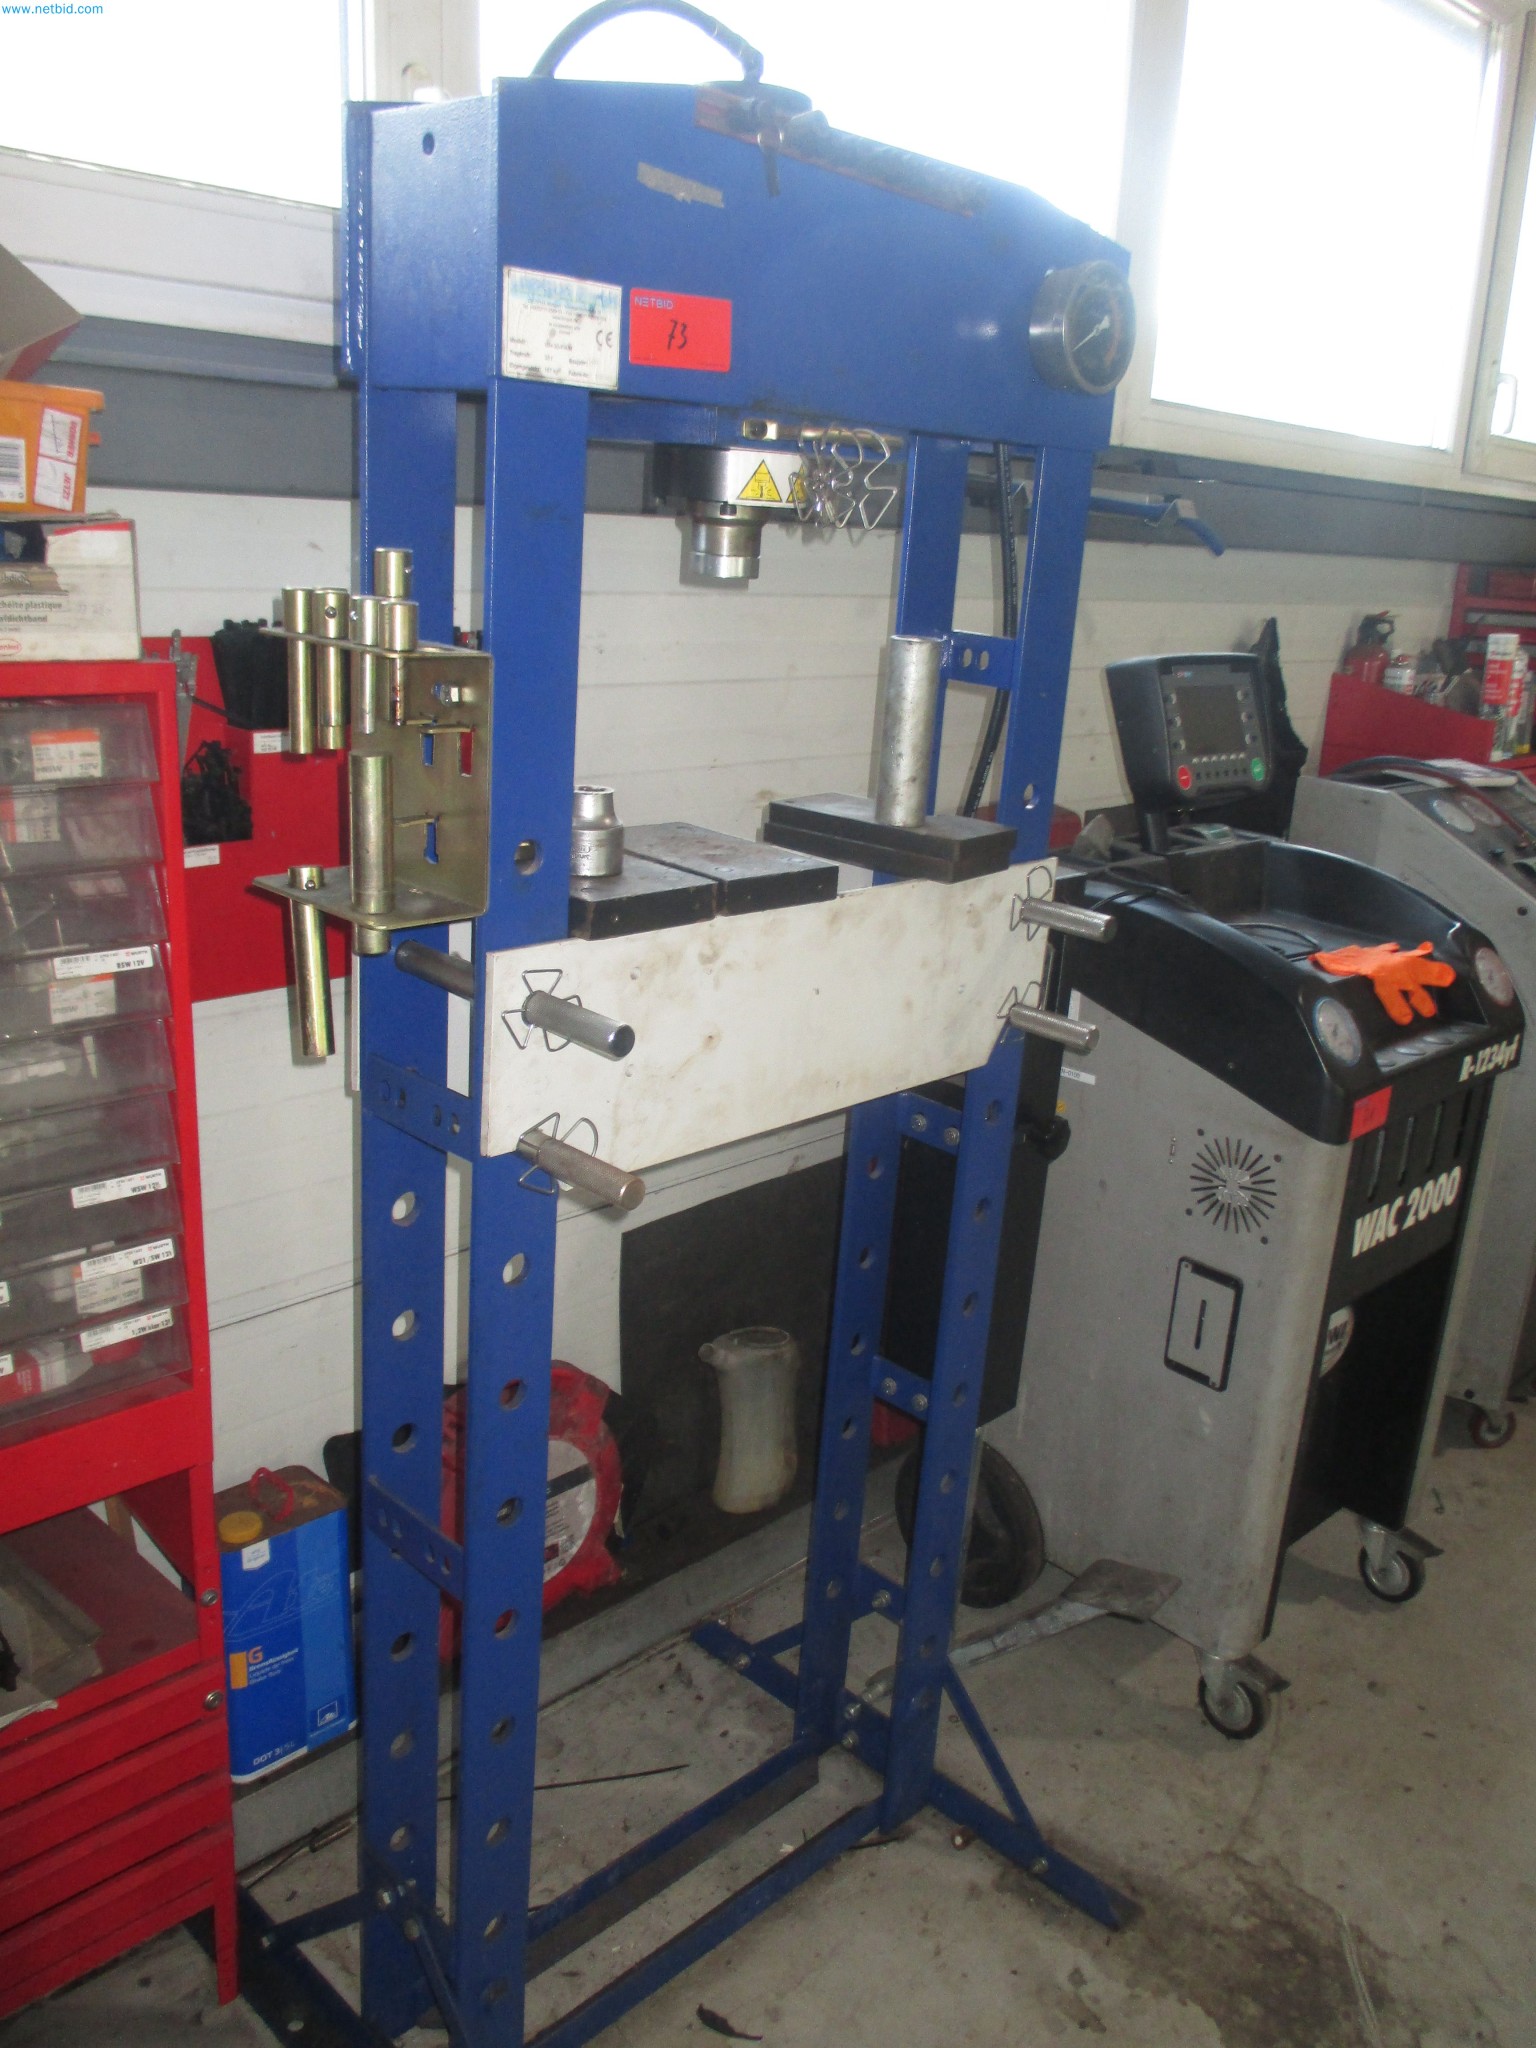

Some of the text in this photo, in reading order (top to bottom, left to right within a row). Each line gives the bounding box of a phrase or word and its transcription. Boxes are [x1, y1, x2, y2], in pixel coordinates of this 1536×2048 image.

[634, 296, 674, 310] NETBID
[667, 318, 688, 350] 73
[25, 600, 63, 612] plastique
[1458, 1034, 1520, 1083] R-1234yf
[1352, 1165, 1462, 1258] WAC 2000
[248, 1646, 264, 1664] G
[253, 1750, 274, 1766] DOT
